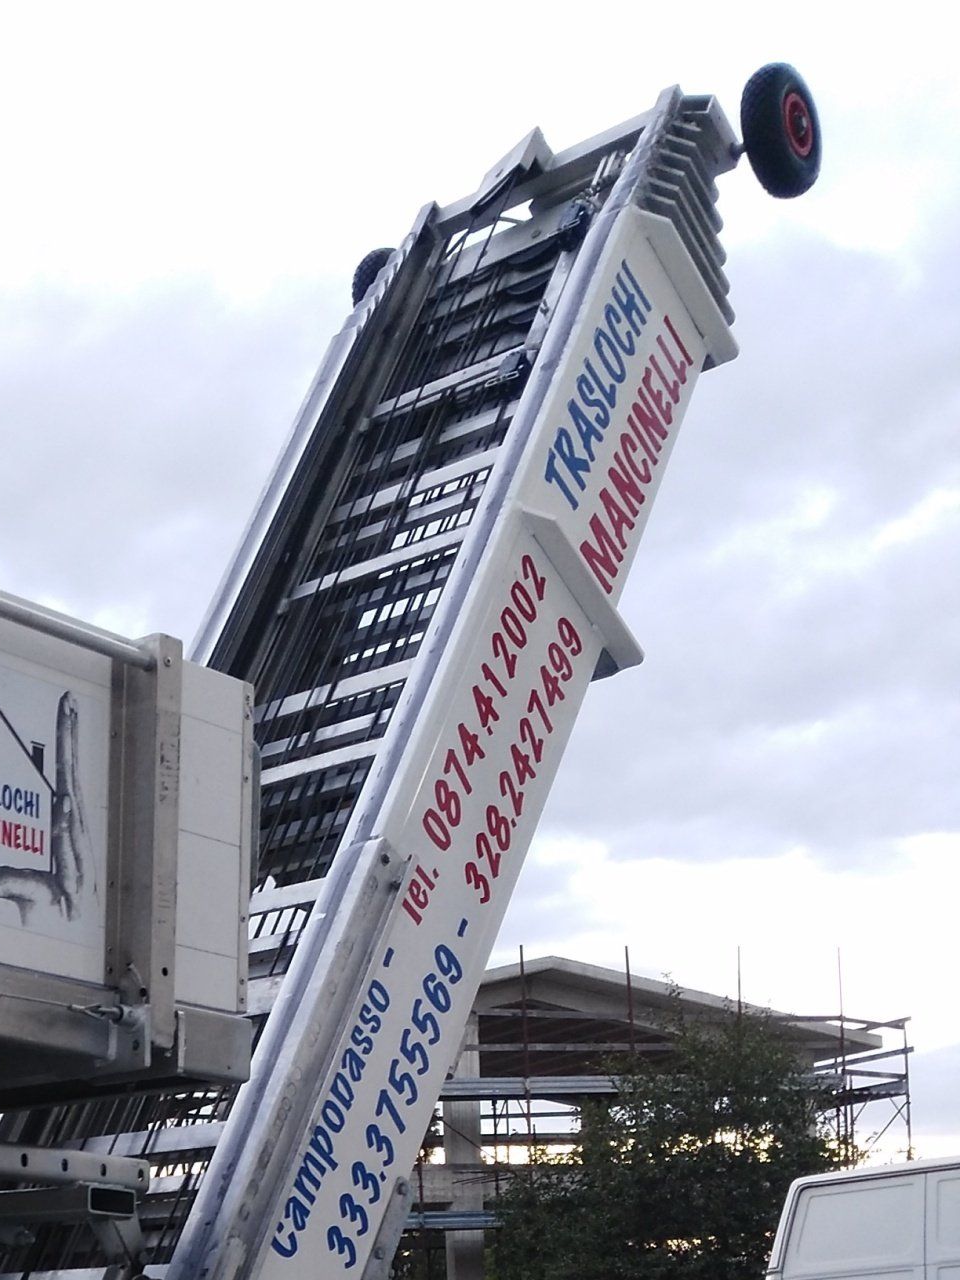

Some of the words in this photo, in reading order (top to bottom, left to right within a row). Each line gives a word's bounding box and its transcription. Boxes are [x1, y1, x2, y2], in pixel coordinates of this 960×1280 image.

[544, 258, 652, 511] TRASLOCHI
[579, 315, 694, 595] MANCINELLI
[422, 554, 546, 851] 0874.412002
[327, 944, 463, 1269] 333.3755569
[465, 617, 582, 904] 328.2427499
